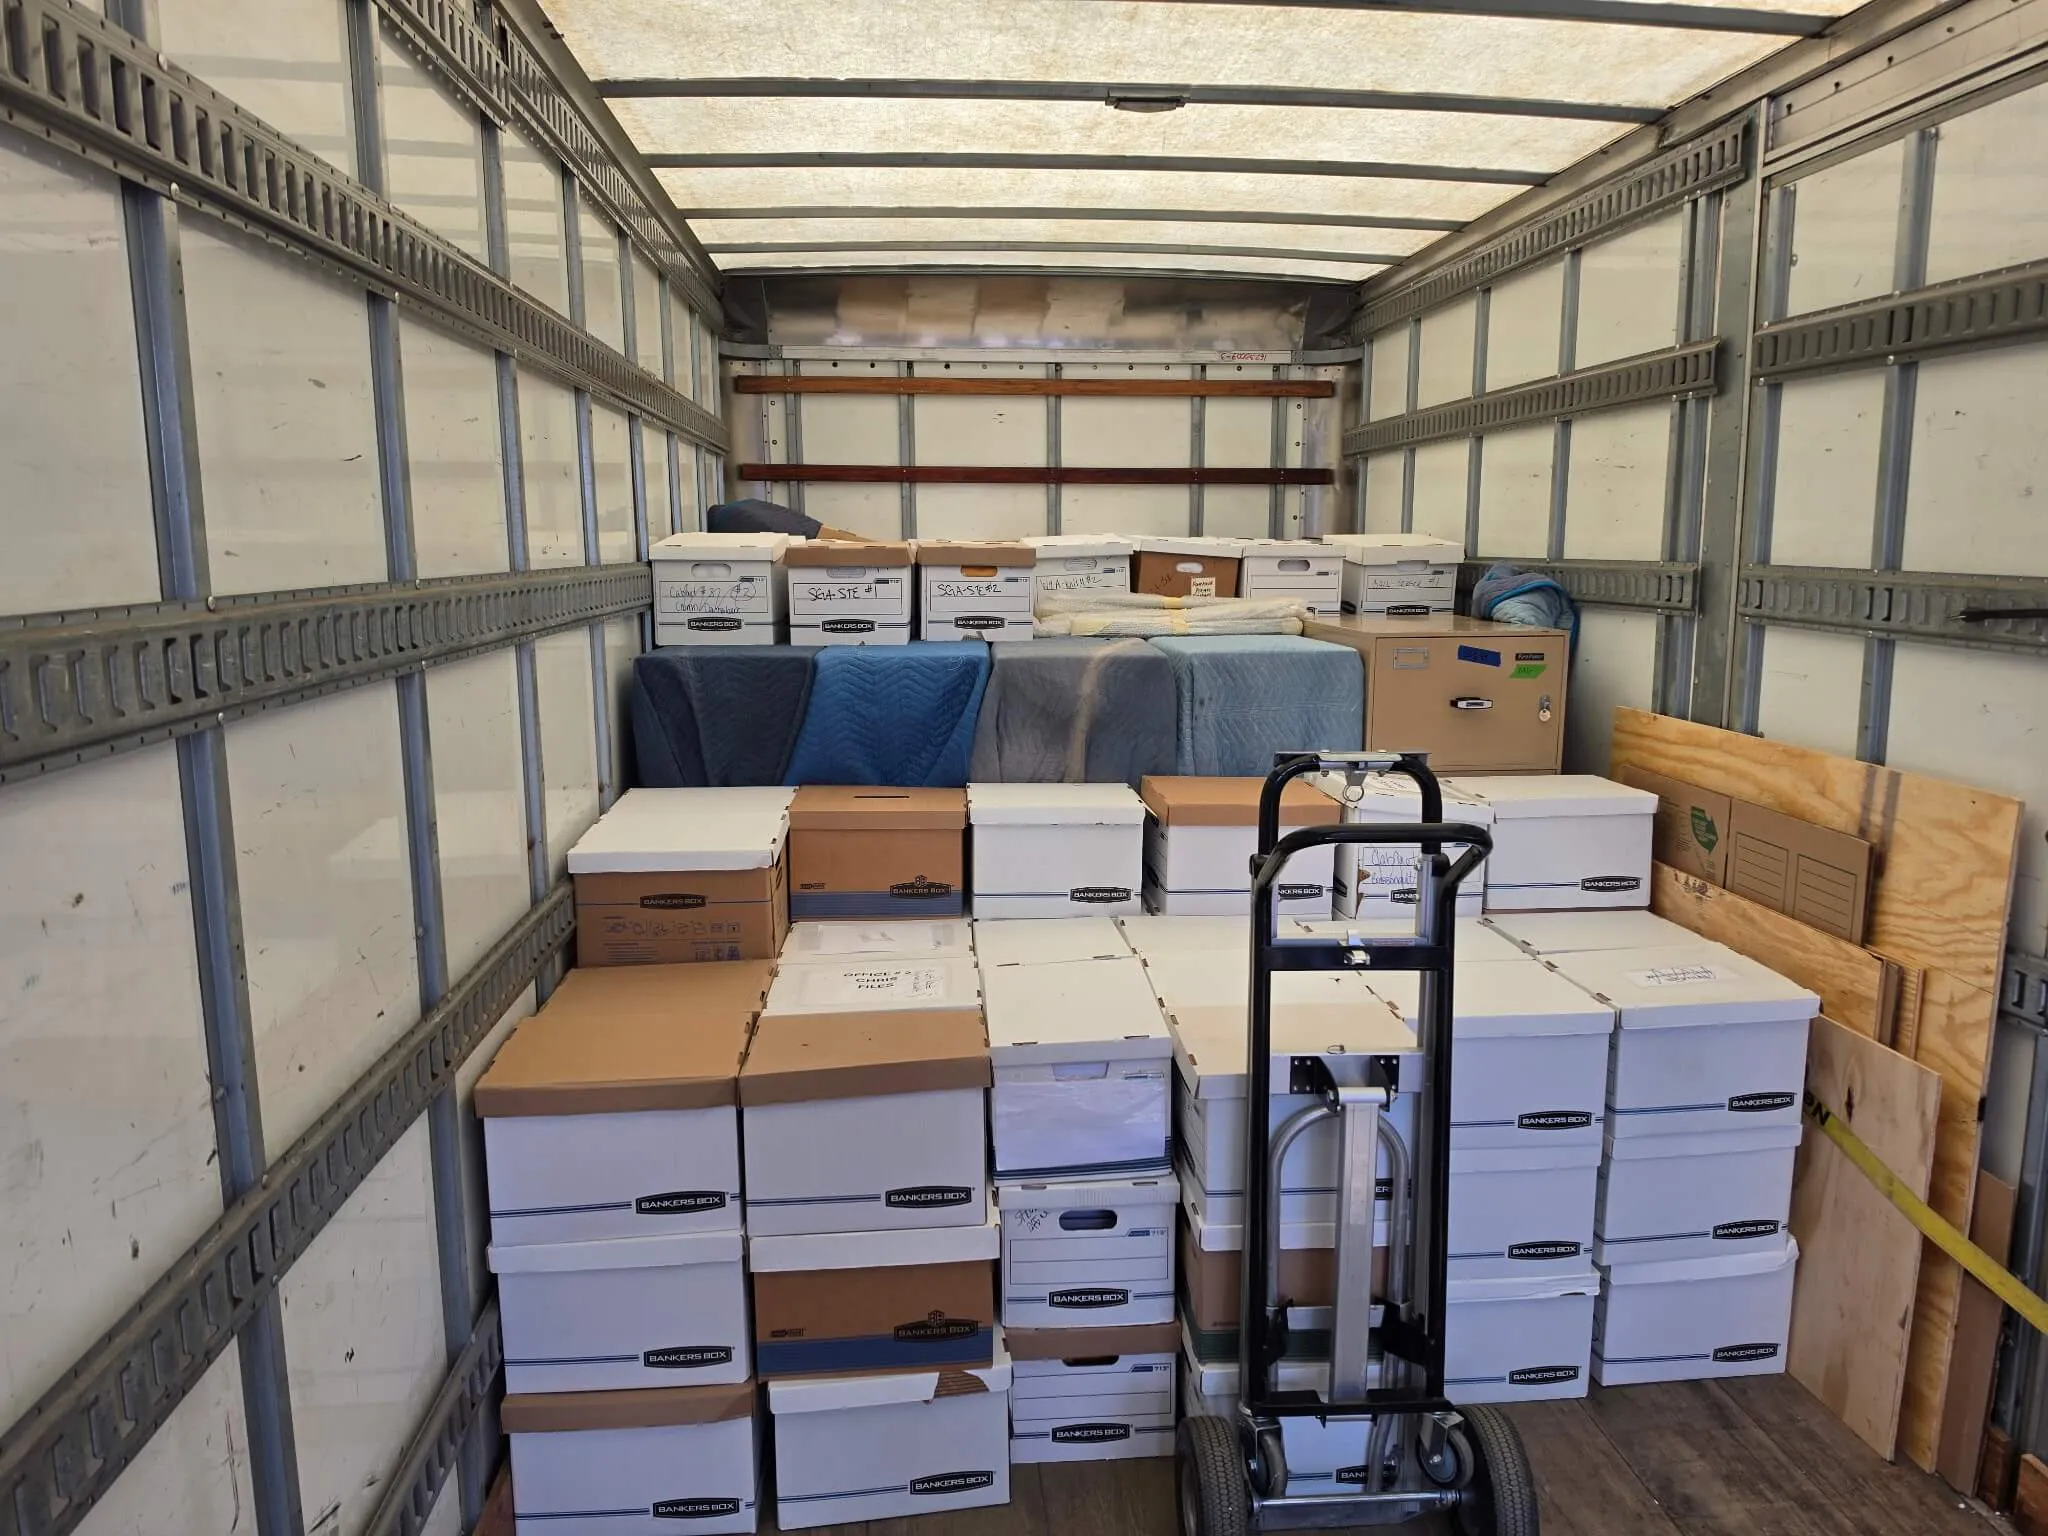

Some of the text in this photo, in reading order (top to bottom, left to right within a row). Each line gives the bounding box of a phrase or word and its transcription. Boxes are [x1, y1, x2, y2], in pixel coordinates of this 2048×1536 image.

[685, 897, 703, 905] BOX
[1732, 1096, 1792, 1107] BANKERS BOX
[1522, 1117, 1567, 1125] BANKERS
[890, 1191, 967, 1202] BANKERS BOX
[641, 1196, 721, 1209] BANKERS BOX
[1716, 1223, 1775, 1236] BANKERS BOX
[1512, 1245, 1577, 1255] BANKERS BOX
[1053, 1293, 1125, 1303] BANKERS BOX
[649, 1351, 727, 1363] BANKERS BOX
[1716, 1349, 1757, 1358] BANKERS
[1513, 1370, 1575, 1381] BANKERS BOX
[1056, 1428, 1125, 1438] BANKERS BOX
[915, 1475, 988, 1490] BANKERS BOX
[658, 1502, 735, 1514] BANKERS BOX
